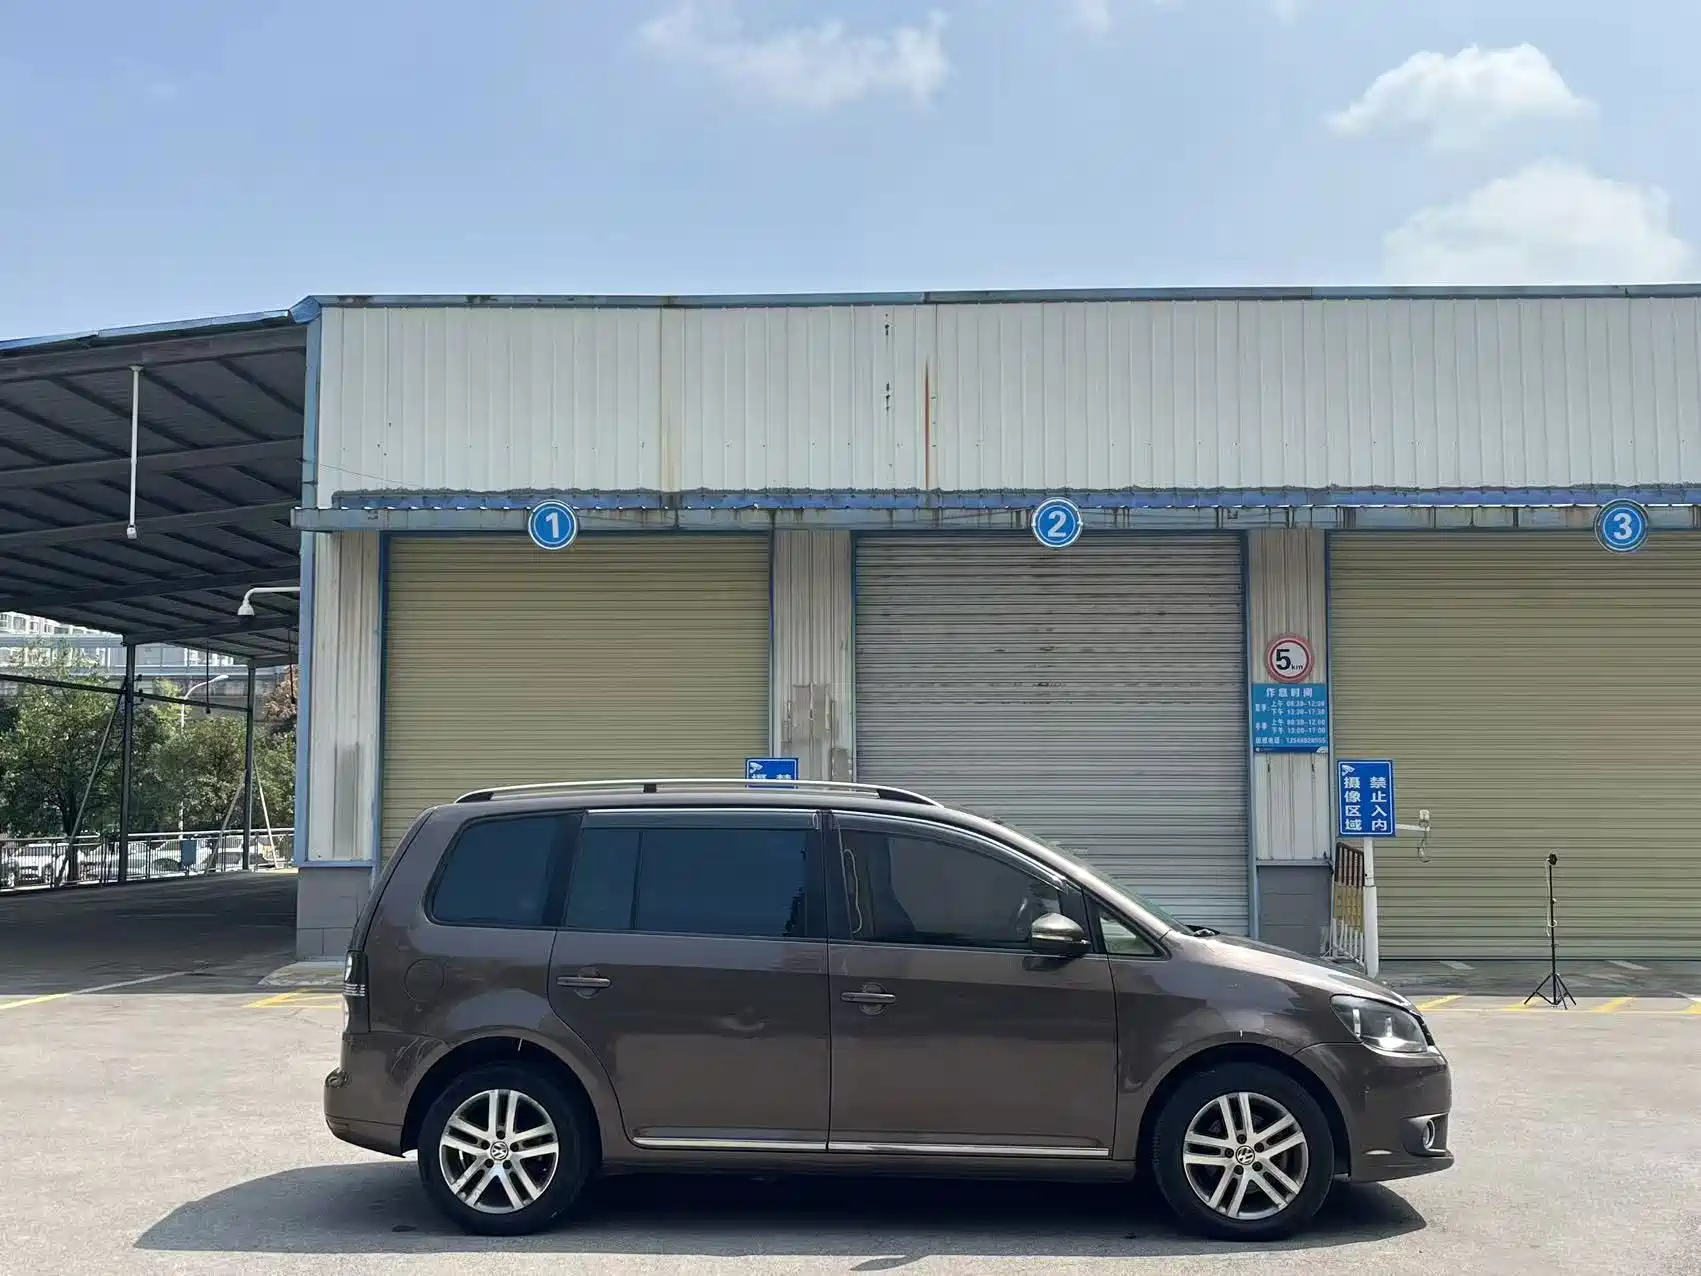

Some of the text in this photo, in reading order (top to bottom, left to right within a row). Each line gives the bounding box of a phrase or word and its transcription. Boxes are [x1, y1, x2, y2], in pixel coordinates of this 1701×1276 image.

[546, 512, 559, 538] 1
[1048, 511, 1067, 537] 2
[1614, 513, 1632, 539] 3
[1266, 688, 1313, 697] 作息时间
[1344, 776, 1362, 831] 摄像区域
[1369, 776, 1388, 831] 禁止入内
